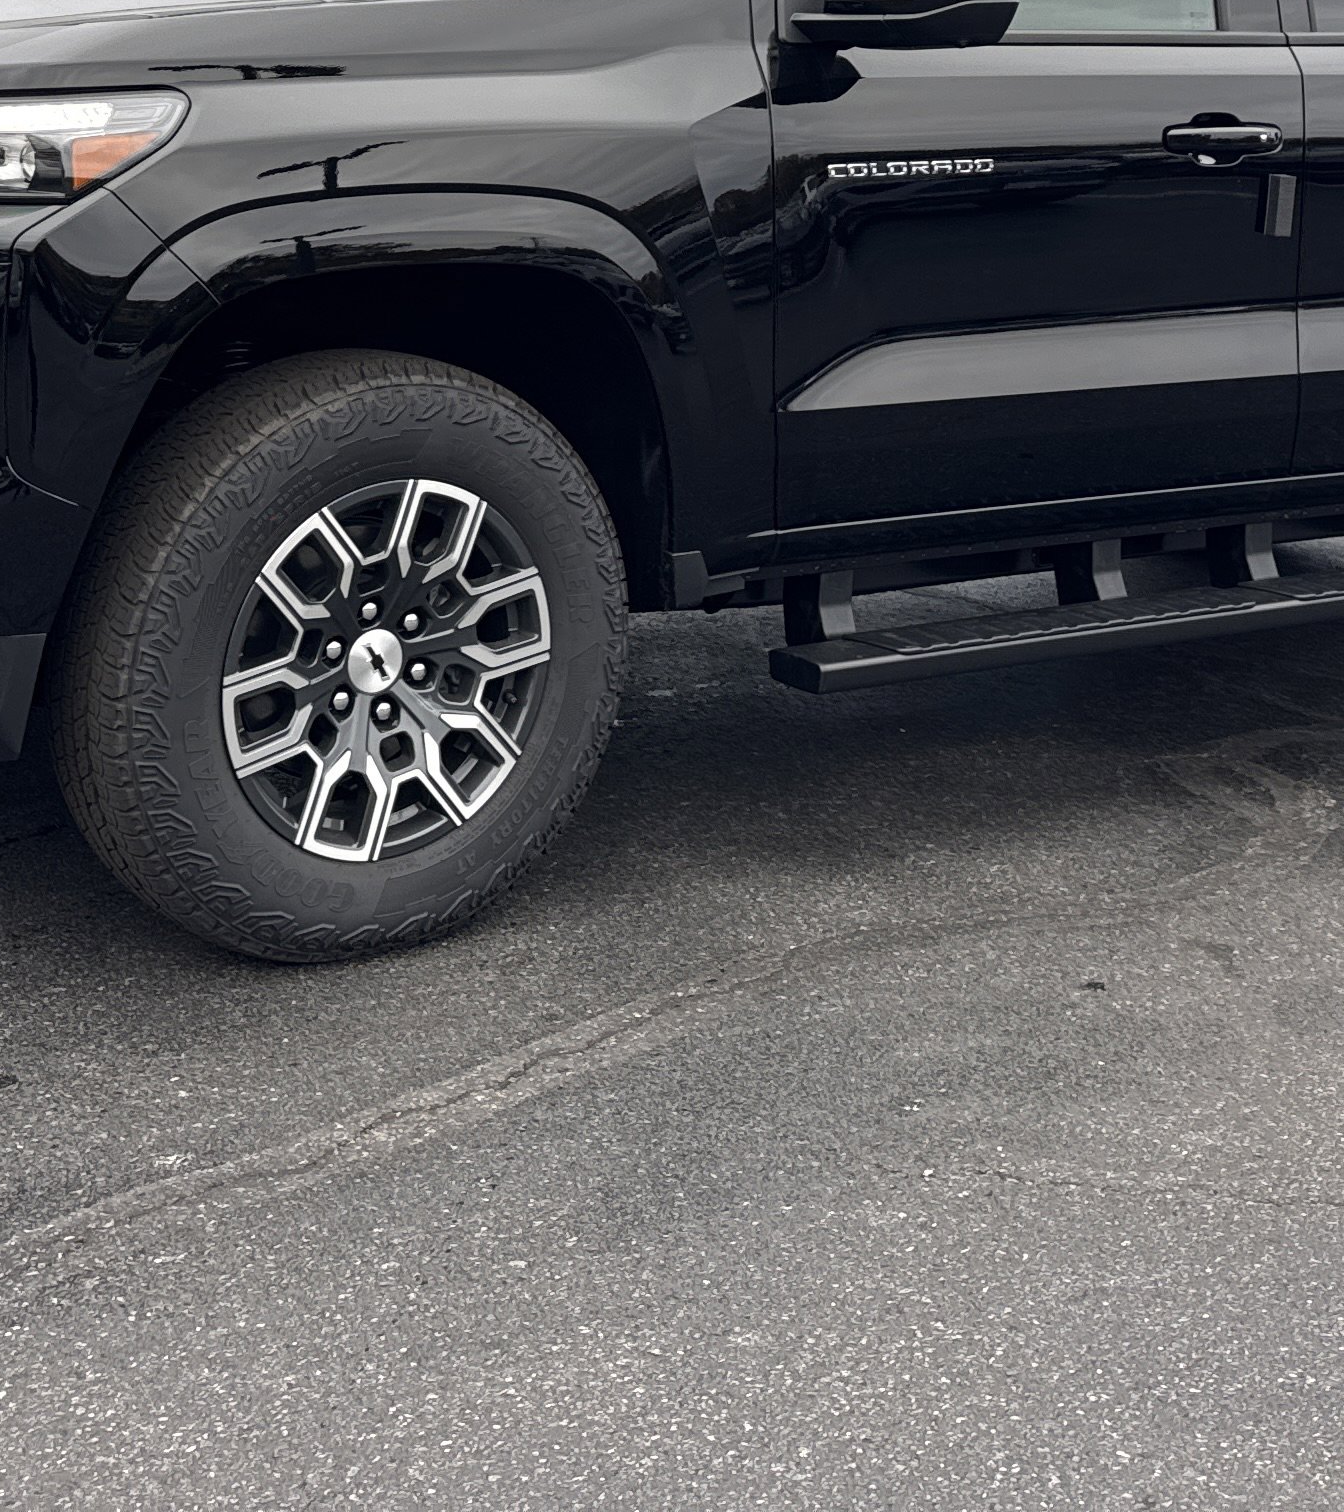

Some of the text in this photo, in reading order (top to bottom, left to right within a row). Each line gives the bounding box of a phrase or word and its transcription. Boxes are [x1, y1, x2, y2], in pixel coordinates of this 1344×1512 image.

[827, 159, 994, 177] COLORADO
[455, 735, 570, 876] TERRITORY AT
